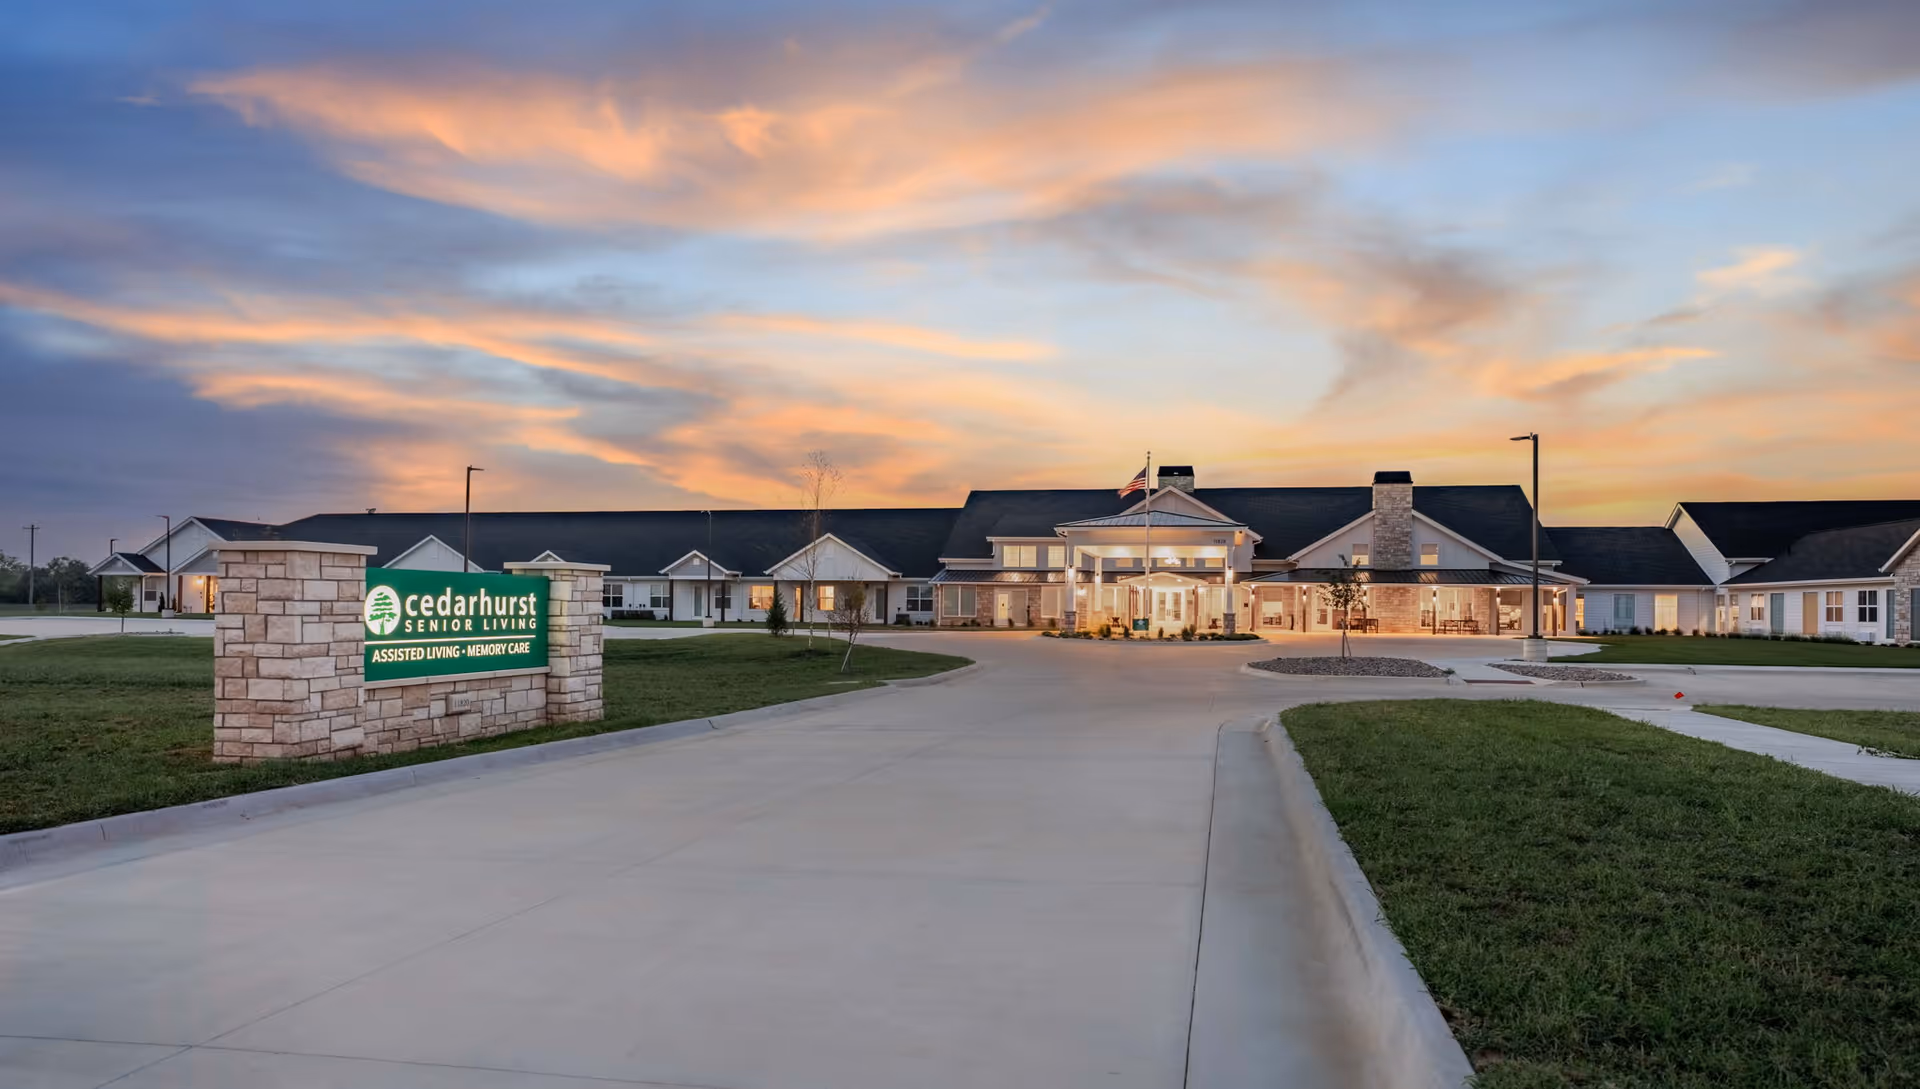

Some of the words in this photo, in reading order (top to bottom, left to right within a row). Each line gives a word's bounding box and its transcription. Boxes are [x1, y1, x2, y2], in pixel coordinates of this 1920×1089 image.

[405, 587, 537, 617] cedarhurst
[405, 619, 473, 633] SENIOR
[483, 618, 537, 630] LIVING
[372, 647, 425, 663] ASSISTED
[426, 645, 460, 660] LIVING
[467, 643, 506, 657] MEMORY
[507, 642, 531, 655] CARE
